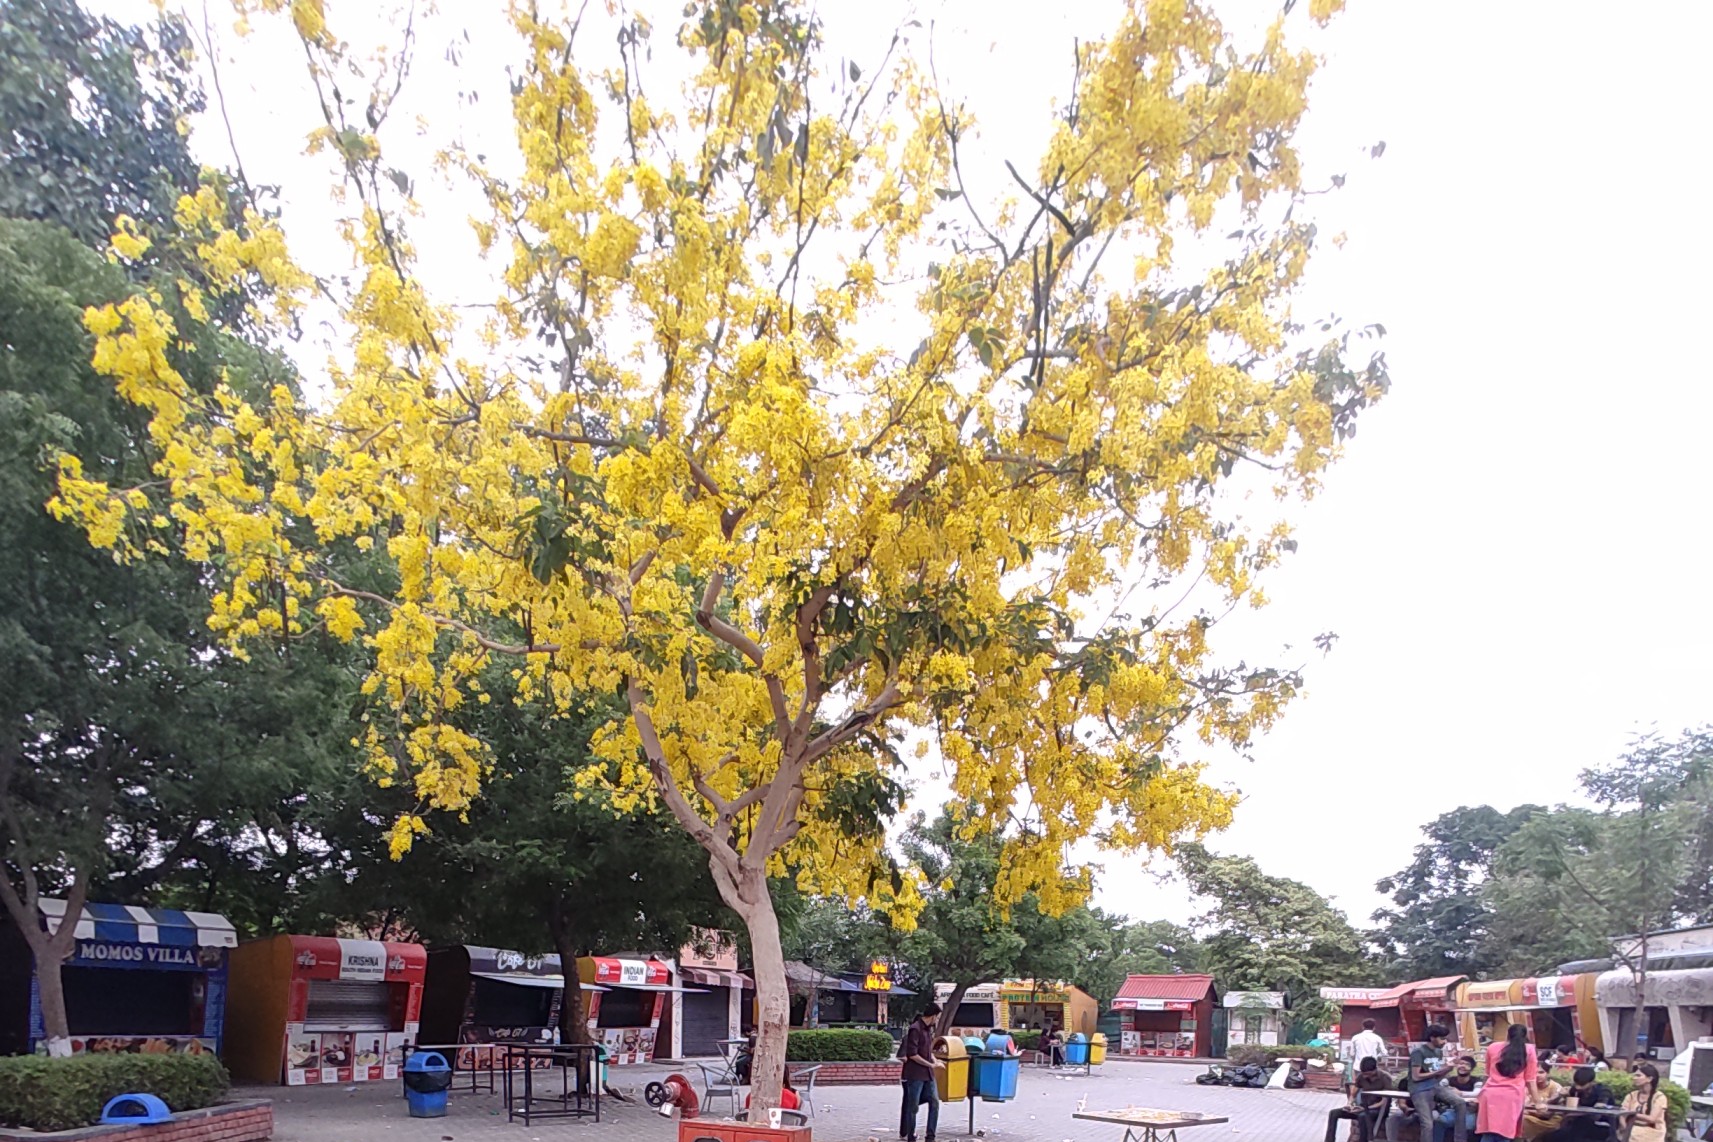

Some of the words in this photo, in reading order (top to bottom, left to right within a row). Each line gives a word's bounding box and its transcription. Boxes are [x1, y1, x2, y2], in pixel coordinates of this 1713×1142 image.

[80, 943, 143, 961] MOMOS
[147, 946, 195, 964] VILLA
[348, 955, 379, 967] KRISHNA
[623, 966, 644, 976] INDIAN
[1326, 991, 1367, 1000] PARATHA
[1539, 986, 1552, 997] SCF
